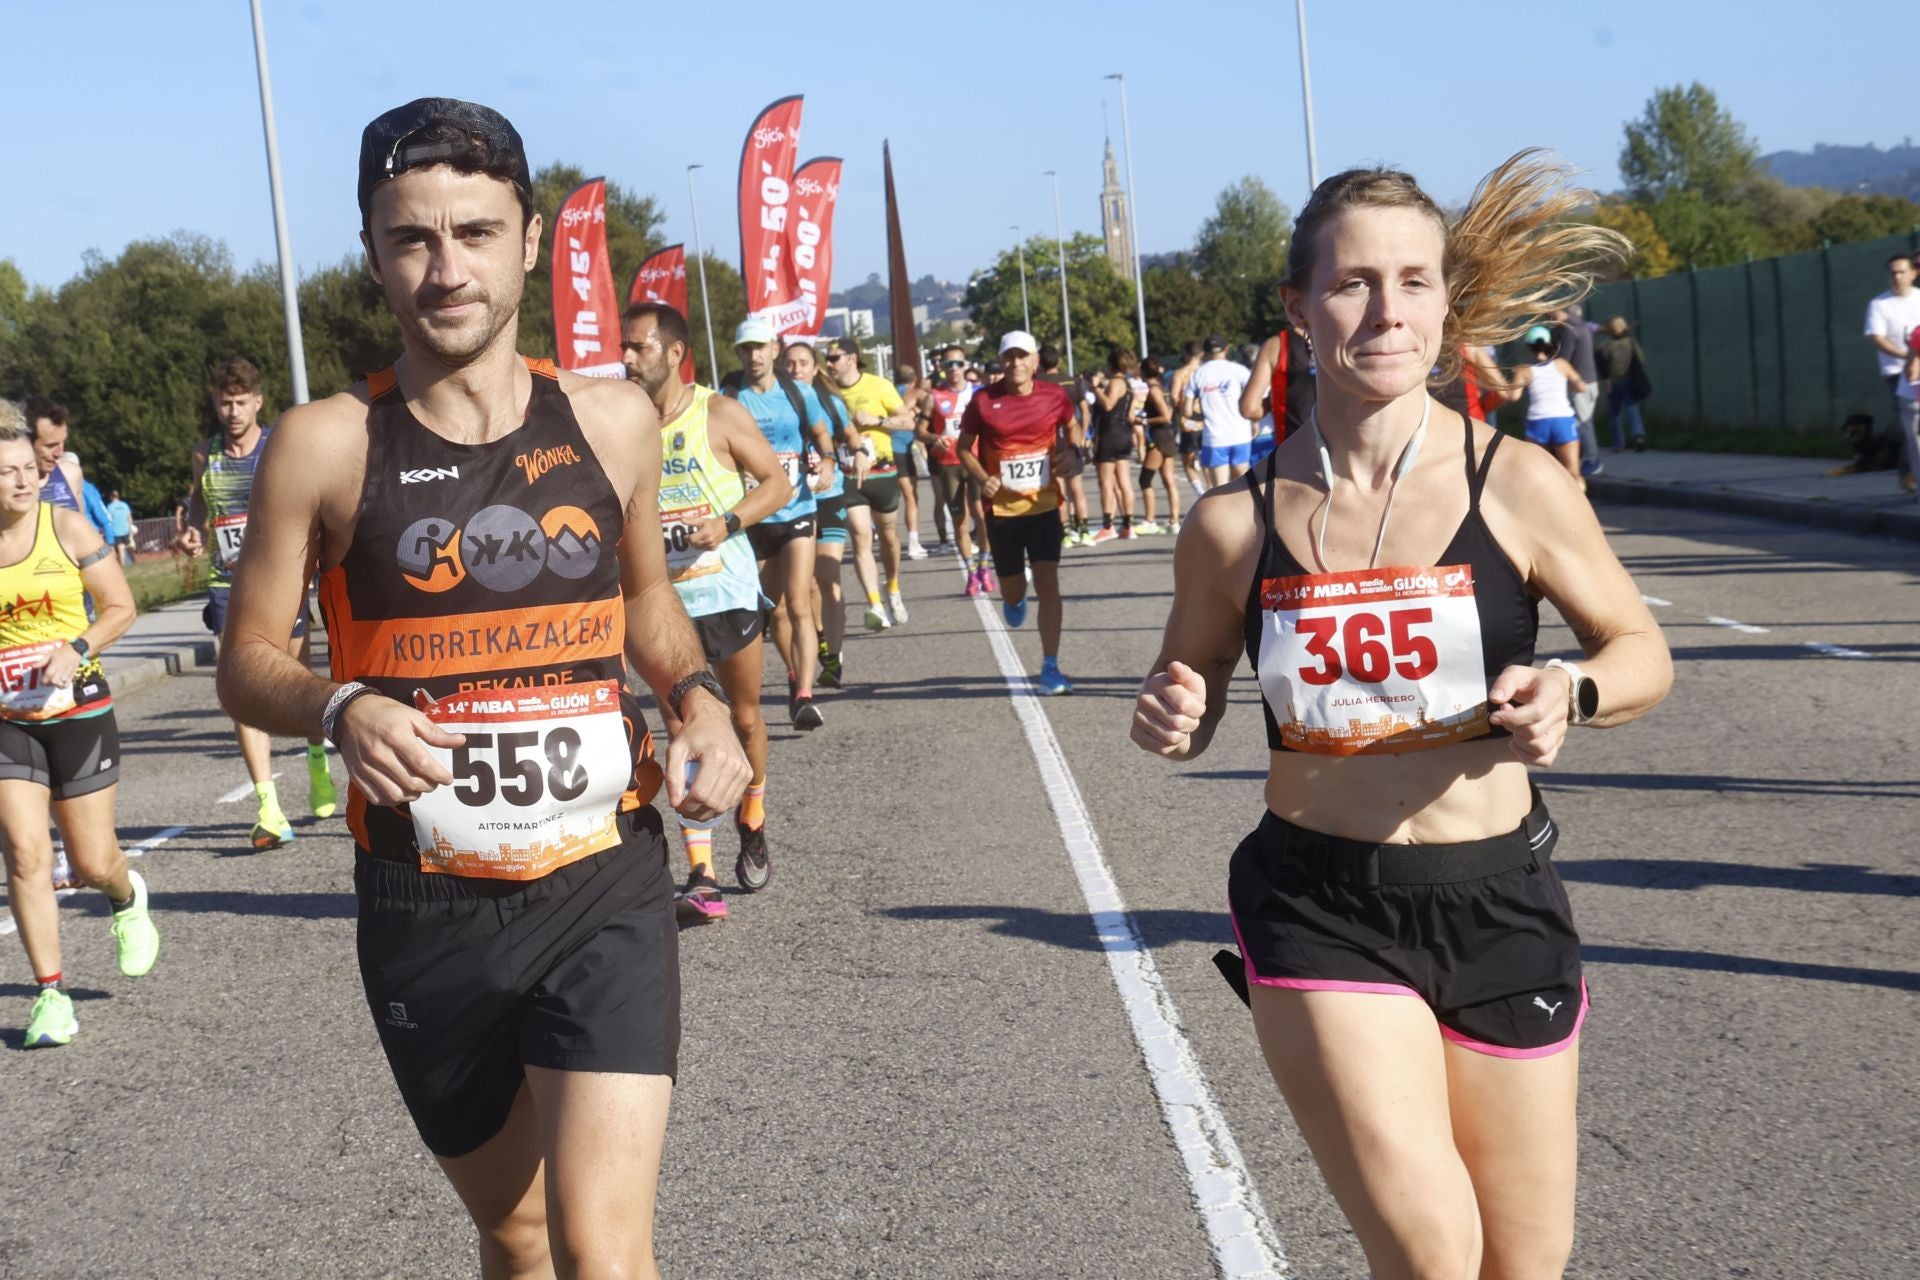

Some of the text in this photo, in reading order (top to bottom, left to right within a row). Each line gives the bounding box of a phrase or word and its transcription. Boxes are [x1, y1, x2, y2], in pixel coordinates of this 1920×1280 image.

[569, 236, 592, 301] 45'
[1008, 460, 1045, 479] 1237
[1314, 583, 1358, 598] MBA
[1360, 578, 1384, 587] media
[1360, 584, 1393, 594] maratón
[1393, 574, 1438, 590] GIJÓN
[392, 614, 613, 662] KORRIKAZALEAK
[1295, 608, 1438, 685] 365
[471, 700, 516, 714] MBA
[518, 703, 550, 712] maratón
[550, 692, 589, 710] GIJÓN
[1331, 695, 1415, 707] JULIA HERRERO
[452, 726, 589, 807] 558
[478, 812, 564, 830] AITOR MARTINEZ
